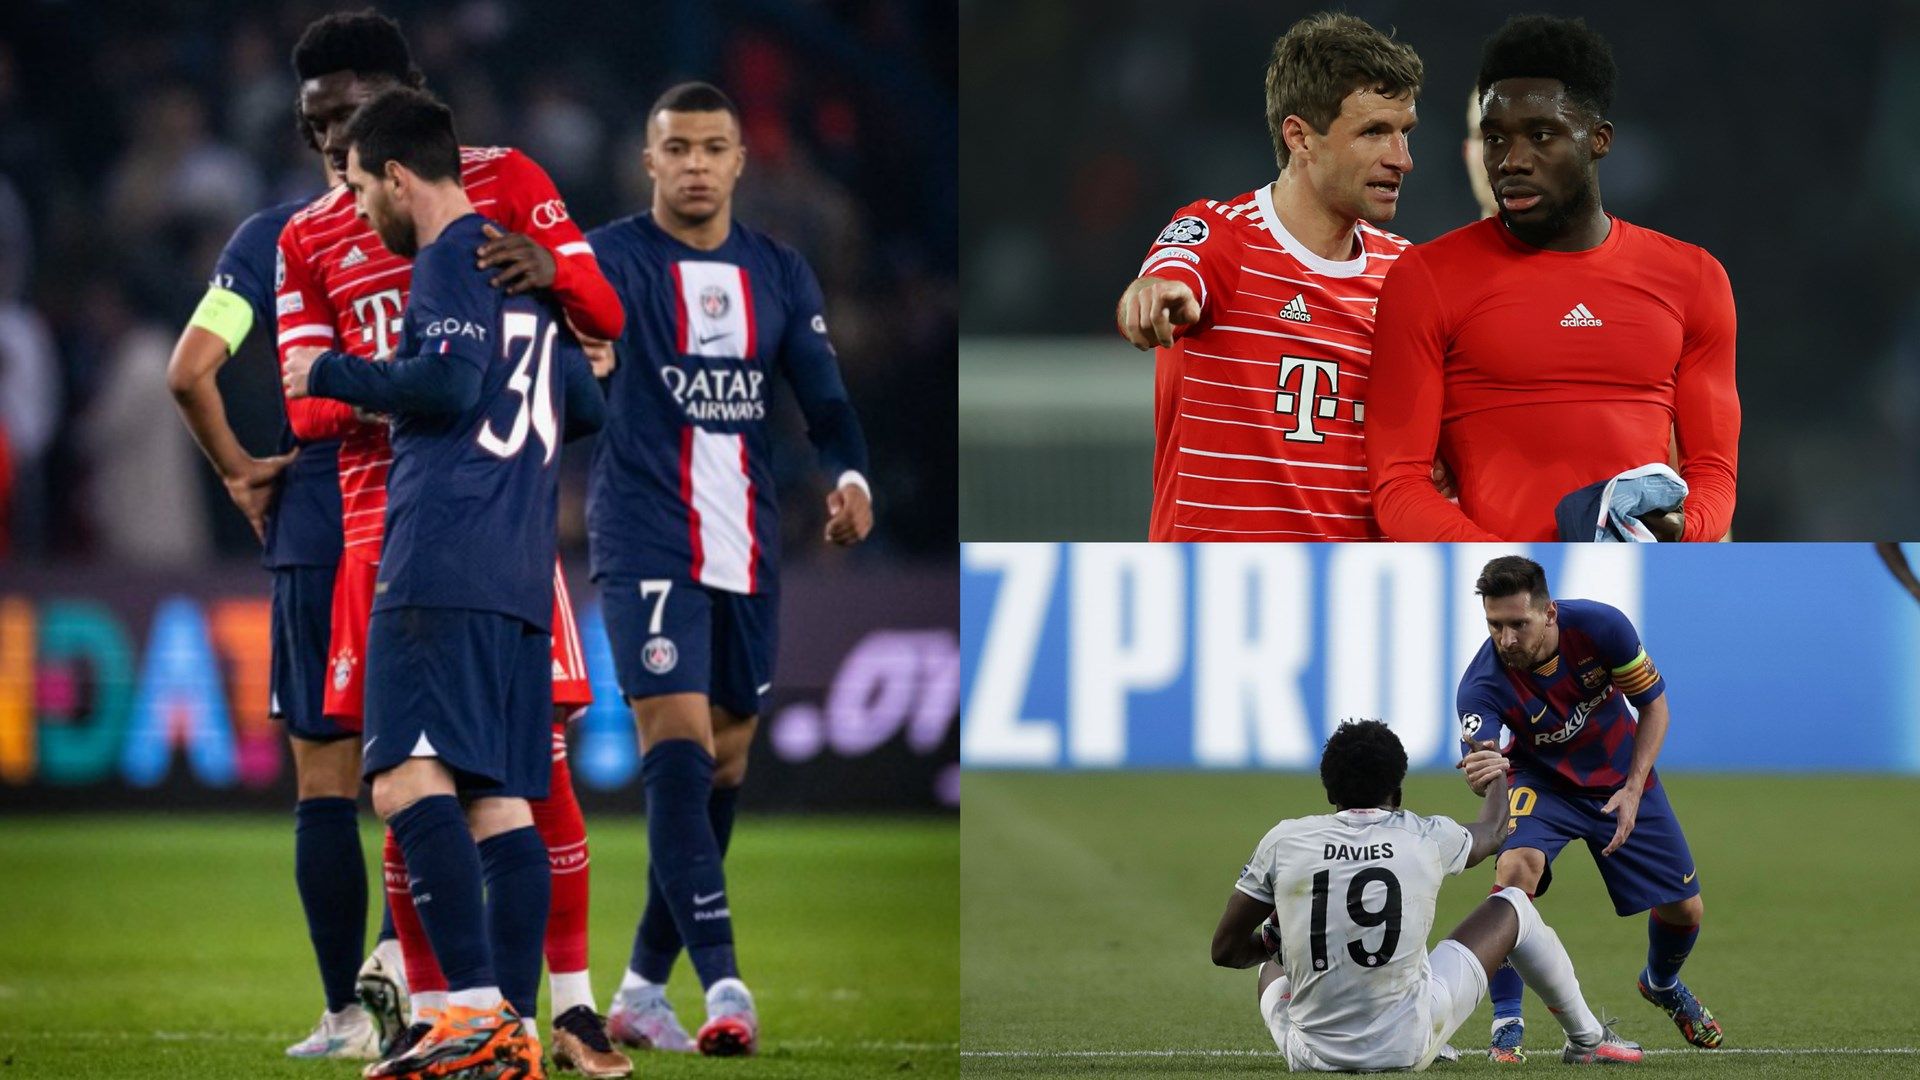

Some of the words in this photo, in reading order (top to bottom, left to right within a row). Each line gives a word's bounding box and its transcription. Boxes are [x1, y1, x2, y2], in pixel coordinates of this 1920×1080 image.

[426, 317, 487, 343] GOAT
[1279, 308, 1312, 323] adidas
[1560, 317, 1603, 327] adidas
[660, 364, 765, 405] QATAR
[686, 400, 766, 421] AIRWAYS
[640, 579, 673, 635] 7
[1535, 684, 1614, 746] Rakuten
[1508, 785, 1538, 817] 0
[1323, 842, 1394, 861] DAVIES
[1310, 866, 1403, 972] 19
